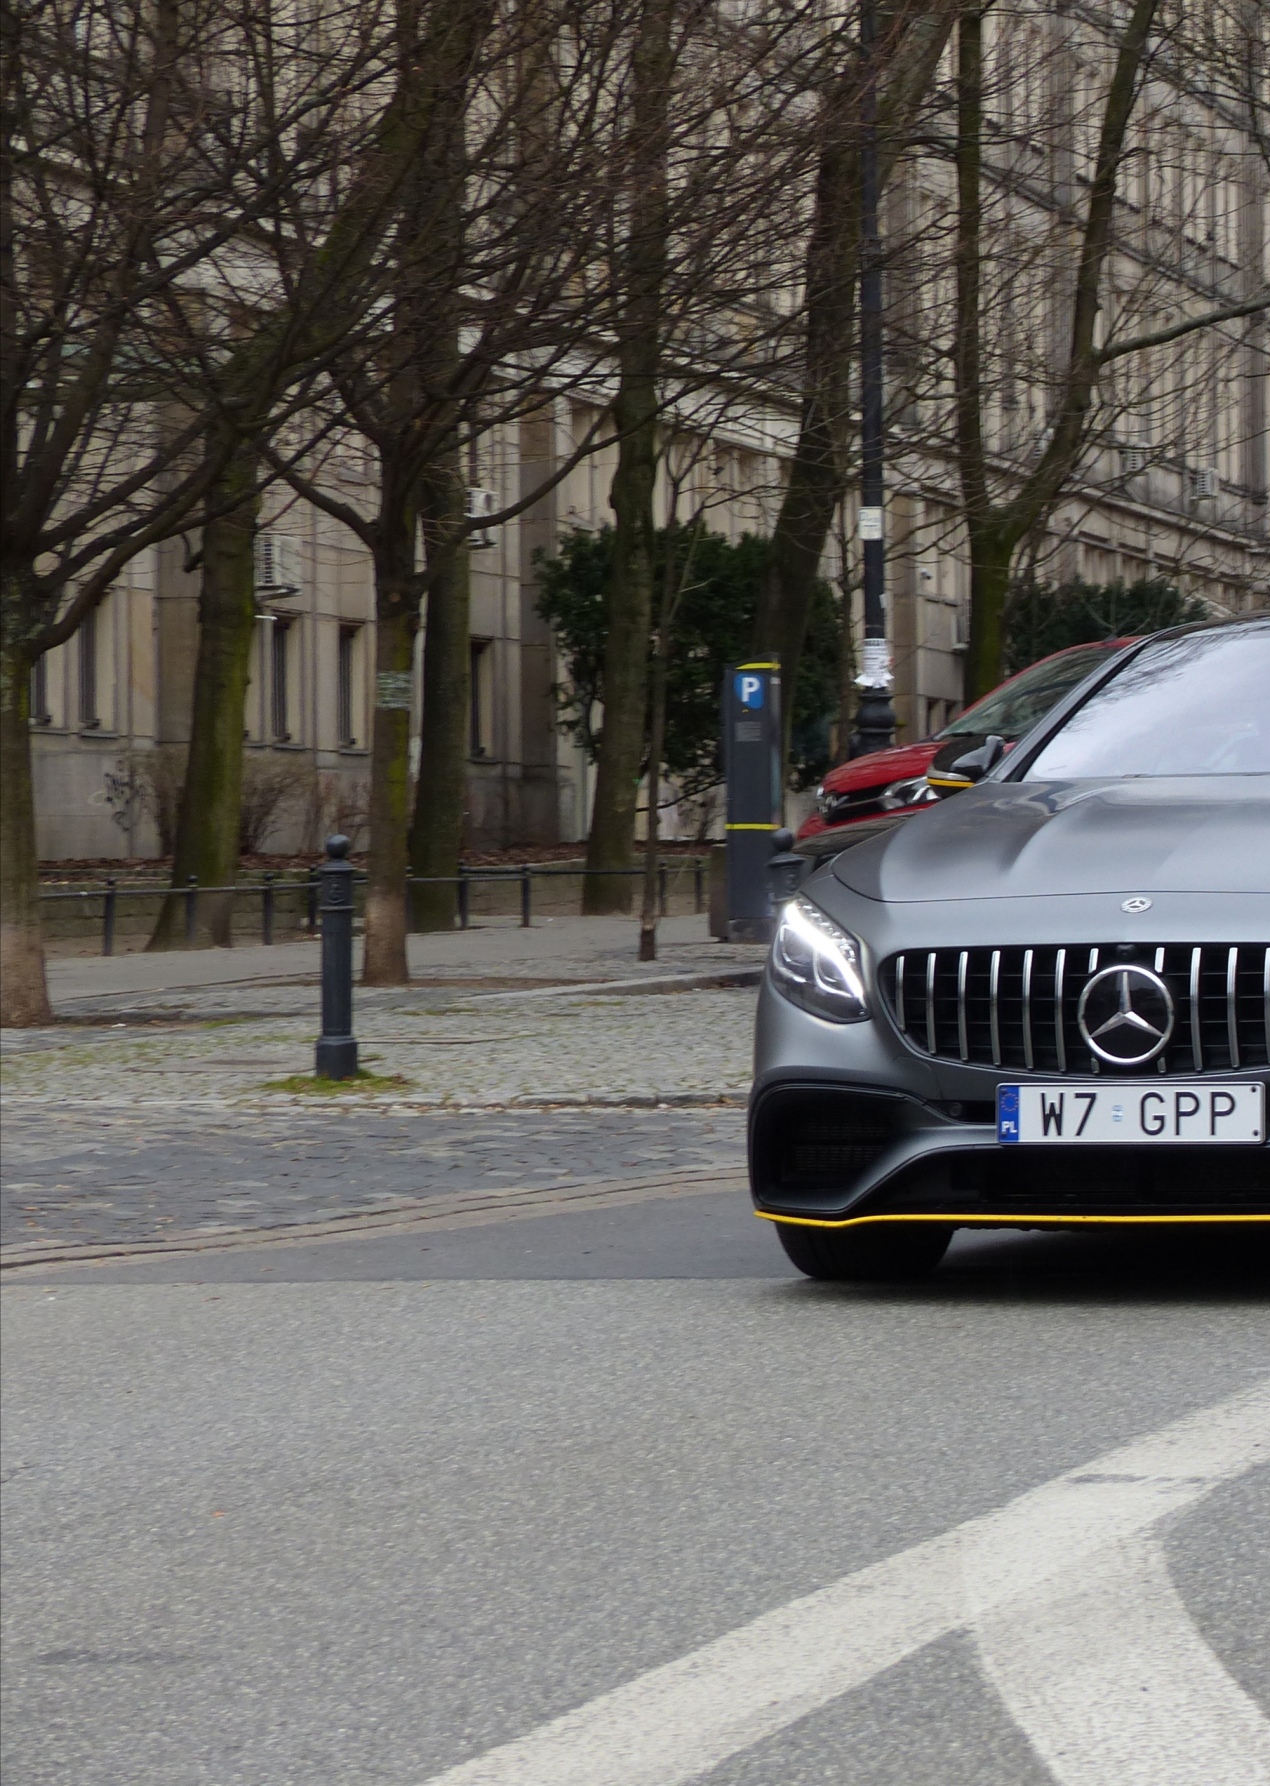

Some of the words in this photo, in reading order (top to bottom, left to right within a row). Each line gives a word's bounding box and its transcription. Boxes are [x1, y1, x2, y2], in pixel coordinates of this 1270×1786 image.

[741, 676, 761, 703] P
[1001, 1121, 1018, 1133] PL
[1040, 1091, 1098, 1137] W7
[1139, 1091, 1236, 1137] GPP
